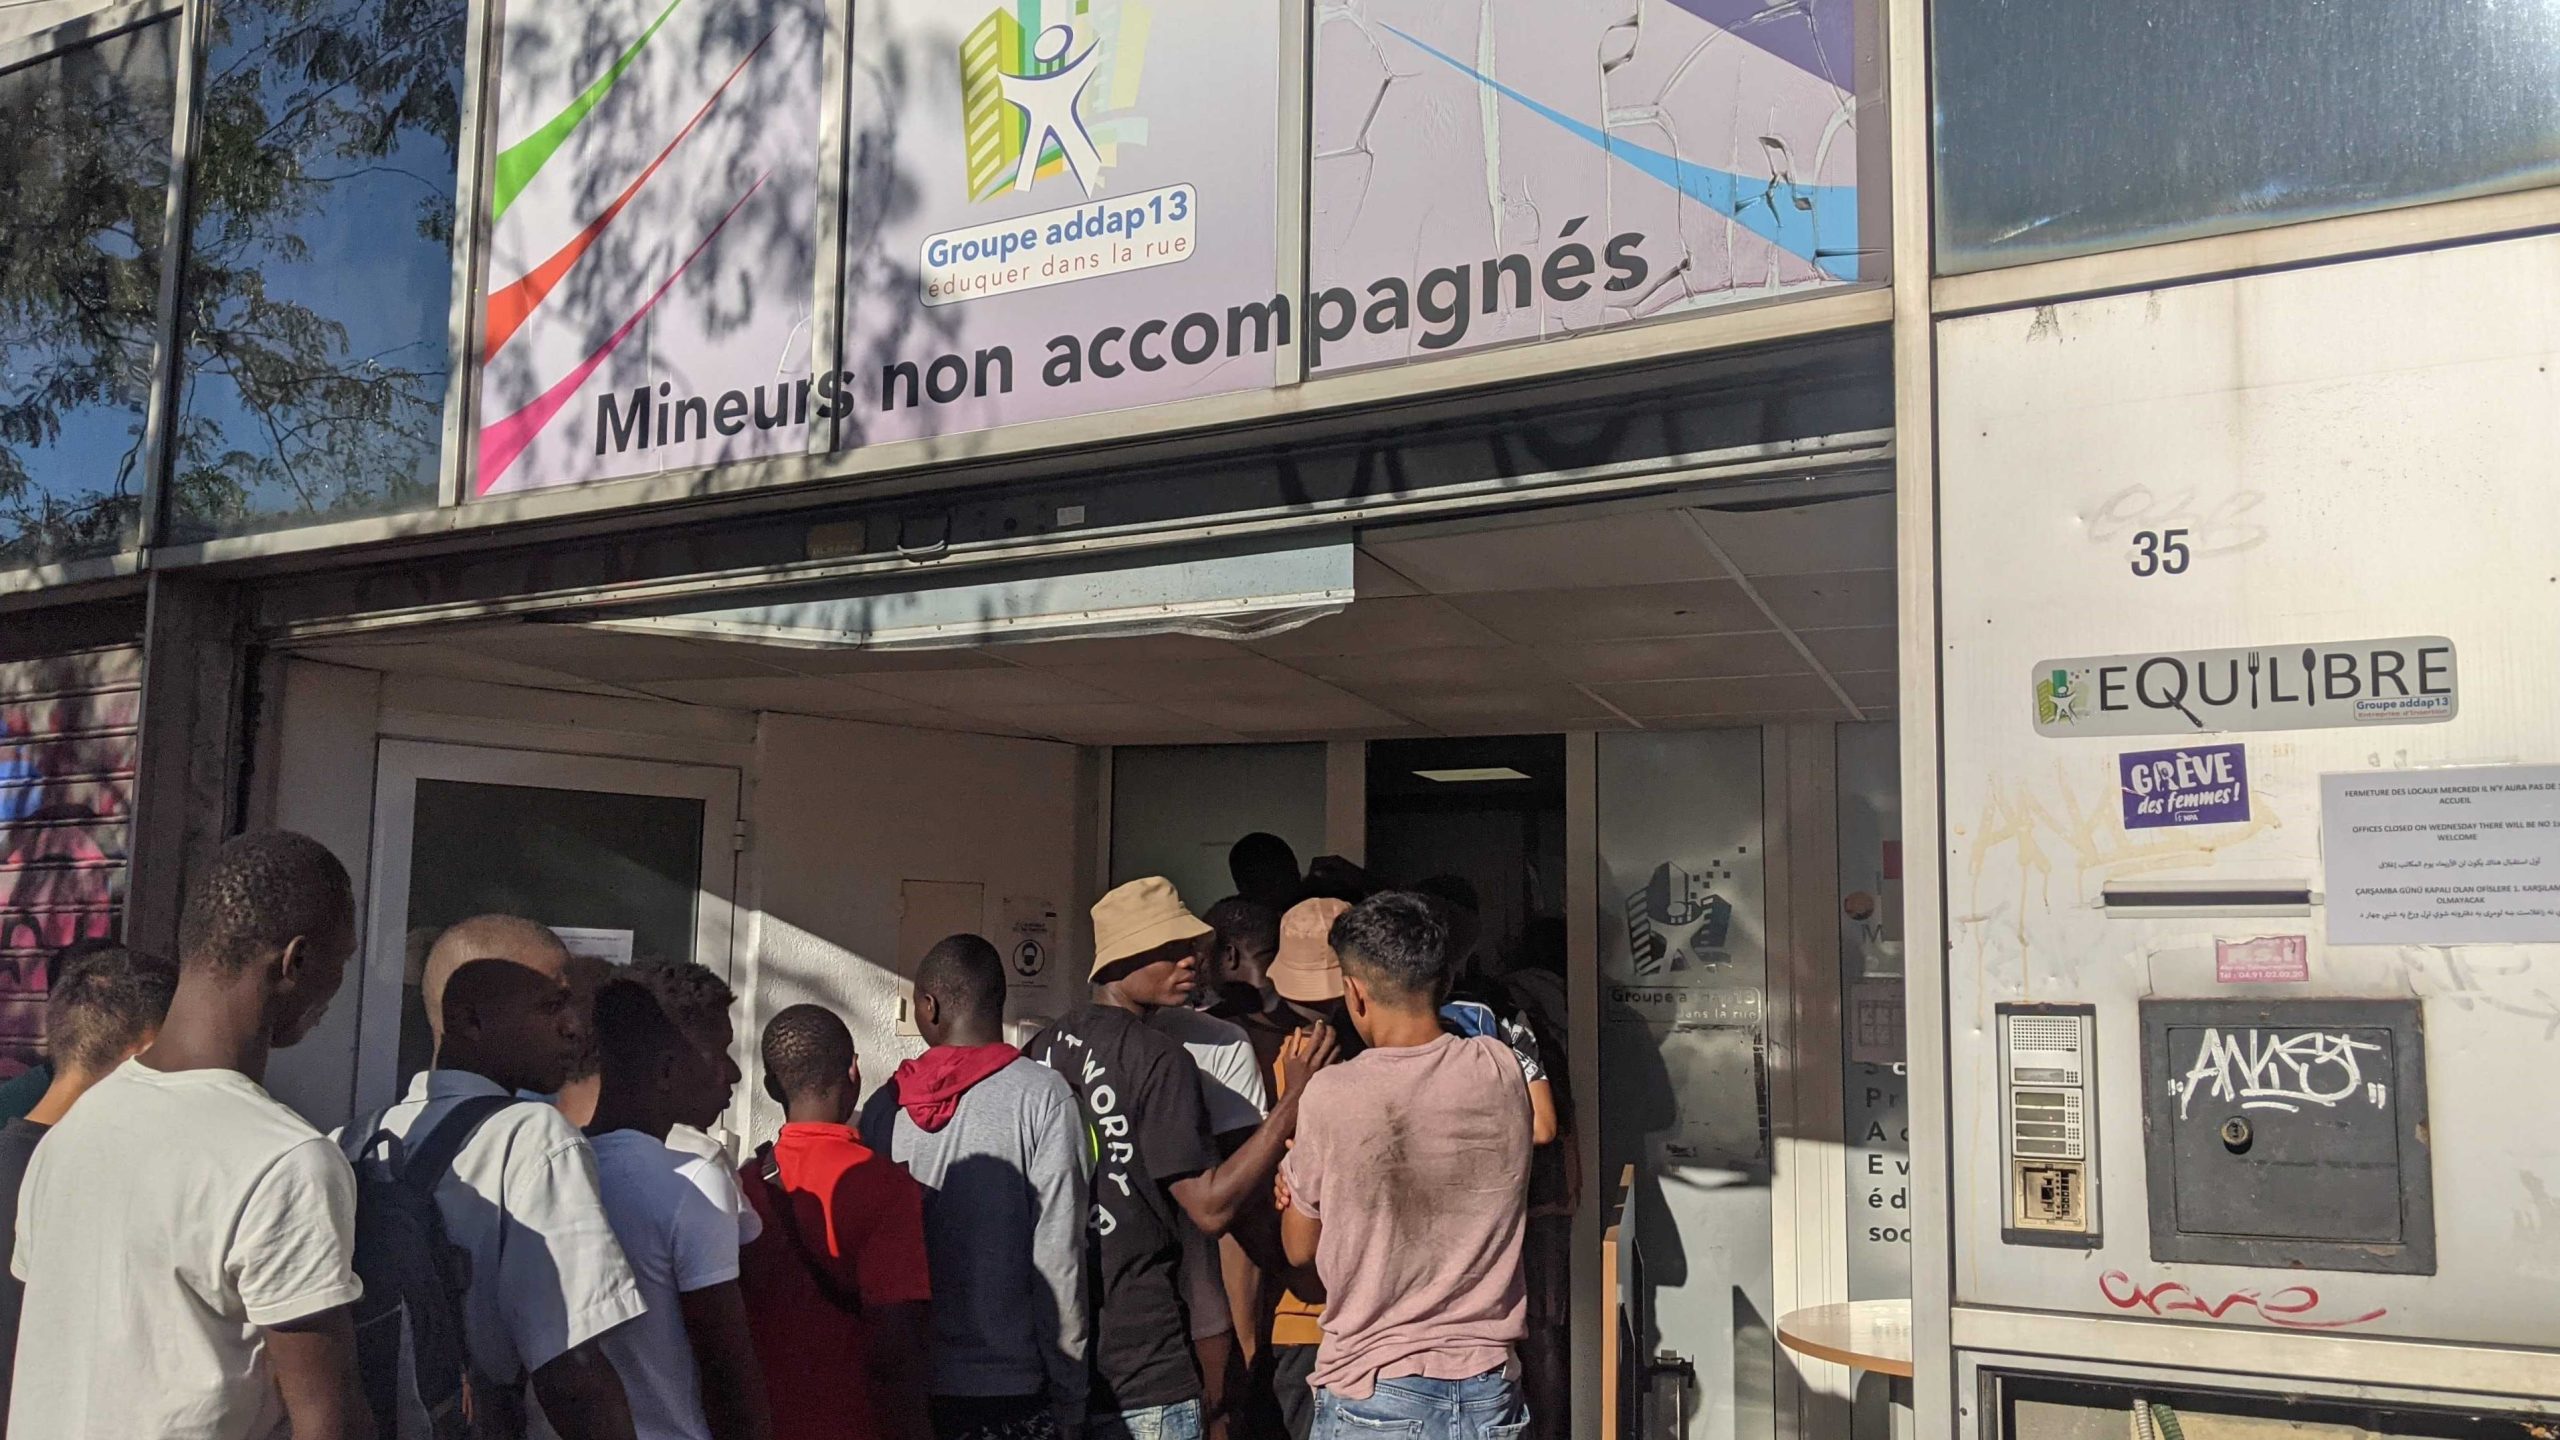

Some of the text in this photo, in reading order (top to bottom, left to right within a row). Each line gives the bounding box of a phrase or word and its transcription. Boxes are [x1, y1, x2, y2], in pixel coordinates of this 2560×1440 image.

[928, 191, 1188, 267] Groupe addap13
[928, 236, 1188, 298] éduquer dans la rue
[595, 216, 1649, 456] Mineurs non accompagnés
[2131, 529, 2191, 578] 35
[2100, 647, 2452, 728] EQUILIBRE
[2356, 697, 2449, 711] Groupe addap13
[2131, 751, 2235, 796] GRÈVE
[2345, 789, 2390, 798] FERMETURE
[2391, 788, 2406, 796] DES
[2407, 786, 2438, 795] LOCAUX
[2440, 785, 2480, 794] MERCREDI
[2481, 785, 2489, 793] IL
[2490, 784, 2502, 792] N'Y
[2505, 784, 2528, 792] AURA
[2528, 783, 2543, 791] PAS
[2545, 782, 2555, 790] DE
[2137, 796, 2165, 815] des
[2439, 797, 2472, 805] ACCUEIL
[2352, 825, 2383, 833] OFFICES
[2384, 824, 2413, 833] CLOSED
[2415, 823, 2427, 831] ON
[2428, 823, 2477, 831] WEDNESDAY
[2479, 822, 2503, 830] THERE
[2505, 821, 2525, 829] WILL
[2526, 821, 2536, 829] BE
[2537, 820, 2550, 828] NO
[2437, 833, 2478, 841] WELCOME
[2355, 887, 2398, 897] ÇARŞAMBA
[2399, 886, 2423, 894] GÜNÜ
[2425, 886, 2452, 894] KAPALI
[2453, 886, 2475, 894] OLAN
[2436, 897, 2486, 905] OLMAYACAK
[1611, 988, 1674, 1005] Groupe
[1714, 1007, 1727, 1019] la
[1082, 1048, 1134, 1198] WORRY
